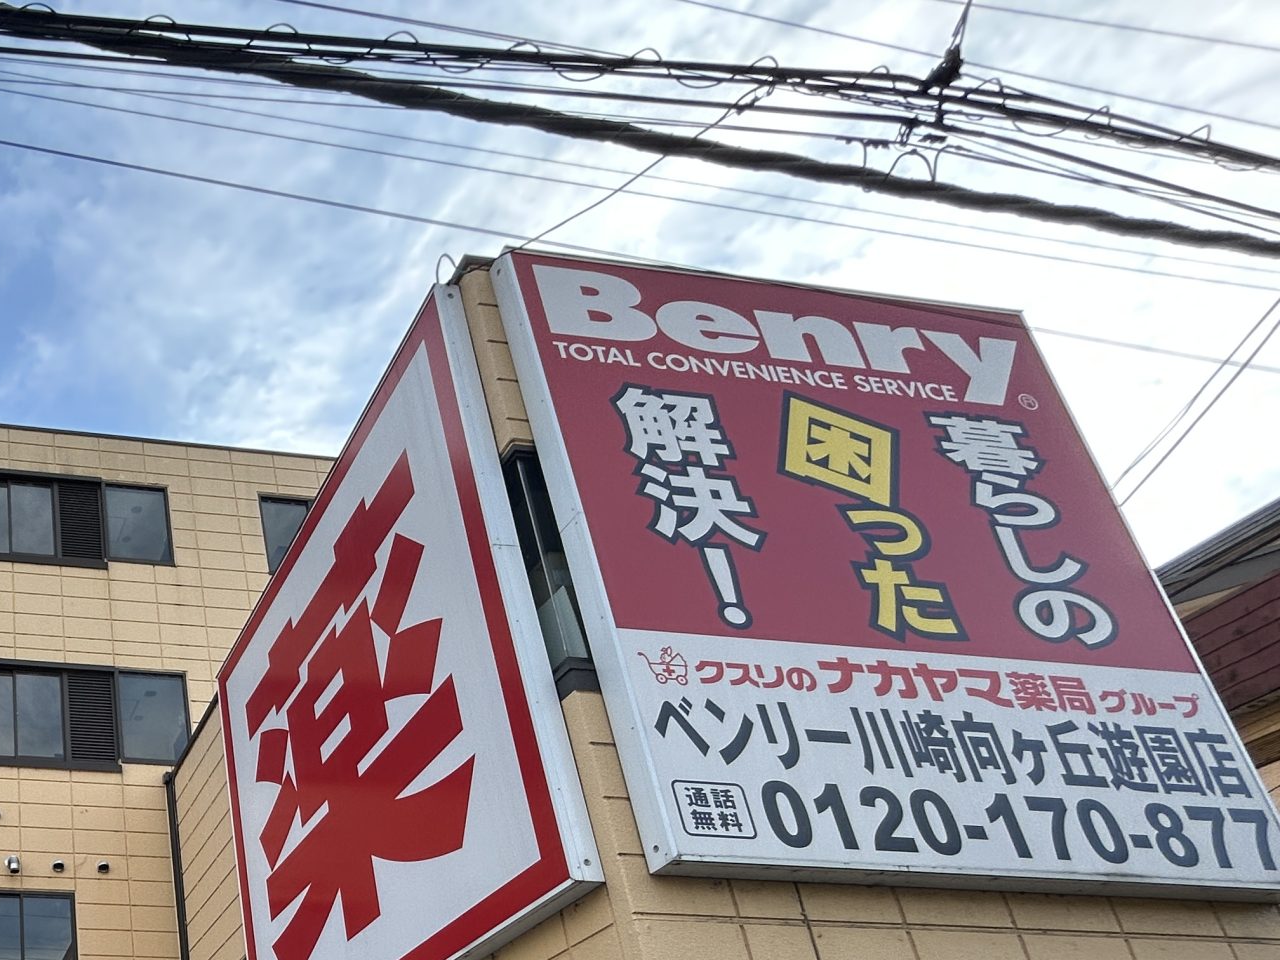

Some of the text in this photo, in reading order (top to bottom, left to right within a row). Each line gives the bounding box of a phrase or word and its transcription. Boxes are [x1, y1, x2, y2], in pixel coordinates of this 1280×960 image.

[532, 264, 1017, 406] Benry
[552, 341, 958, 402] TOTAL CONVENIENCE SERVICE
[778, 391, 969, 641] 困った
[925, 411, 1118, 648] 暮らしの
[685, 786, 738, 811] 通話
[691, 809, 744, 834] 無料
[760, 780, 1280, 871] 0120-170-877
